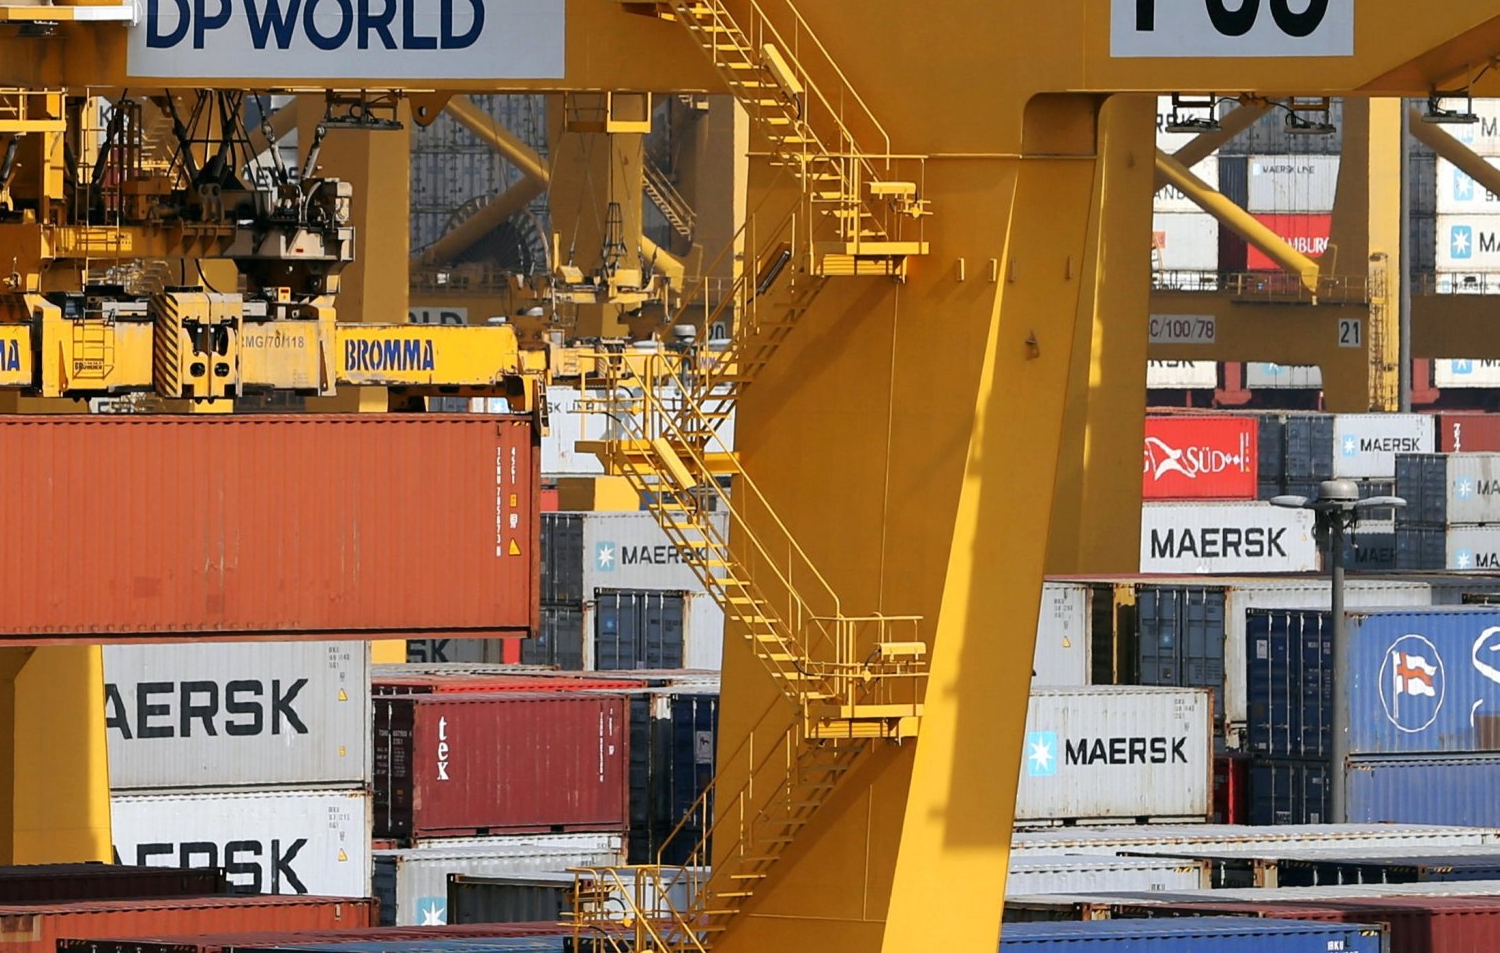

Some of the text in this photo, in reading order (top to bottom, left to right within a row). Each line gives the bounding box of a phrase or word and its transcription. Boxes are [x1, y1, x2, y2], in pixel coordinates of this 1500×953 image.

[1340, 322, 1360, 345] 21
[345, 339, 435, 372] BROMMA
[1360, 437, 1421, 452] MAERSK
[1190, 448, 1226, 475] SÜD
[1151, 527, 1288, 559] MAERSK
[437, 716, 449, 781] tex
[1066, 736, 1188, 765] MAERSK
